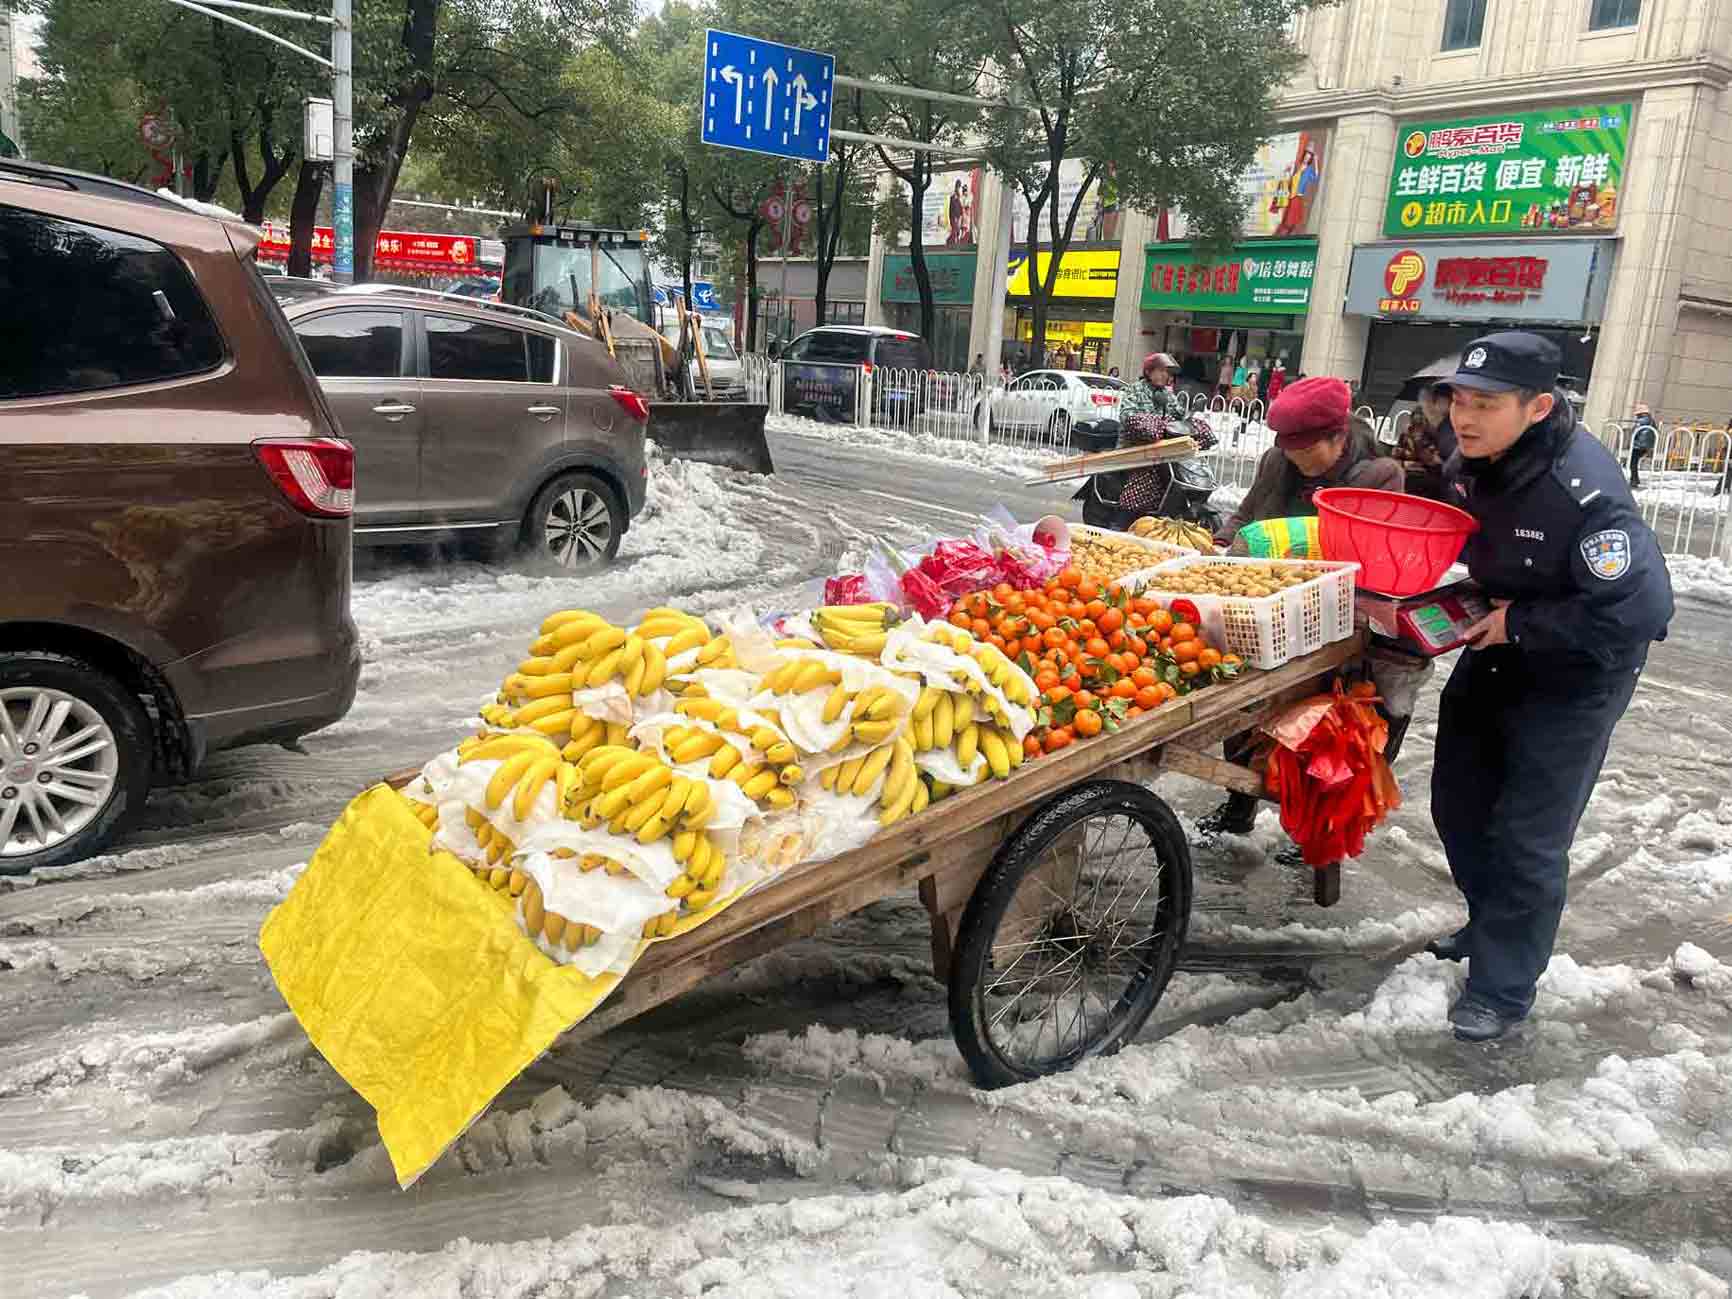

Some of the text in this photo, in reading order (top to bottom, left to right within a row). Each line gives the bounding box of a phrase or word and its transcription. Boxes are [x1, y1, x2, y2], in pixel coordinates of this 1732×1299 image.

[1429, 123, 1523, 149] 鹏泰百货
[1396, 153, 1610, 195] 生鲜百货 便宜 新鲜
[1425, 200, 1512, 226] 超市入口
